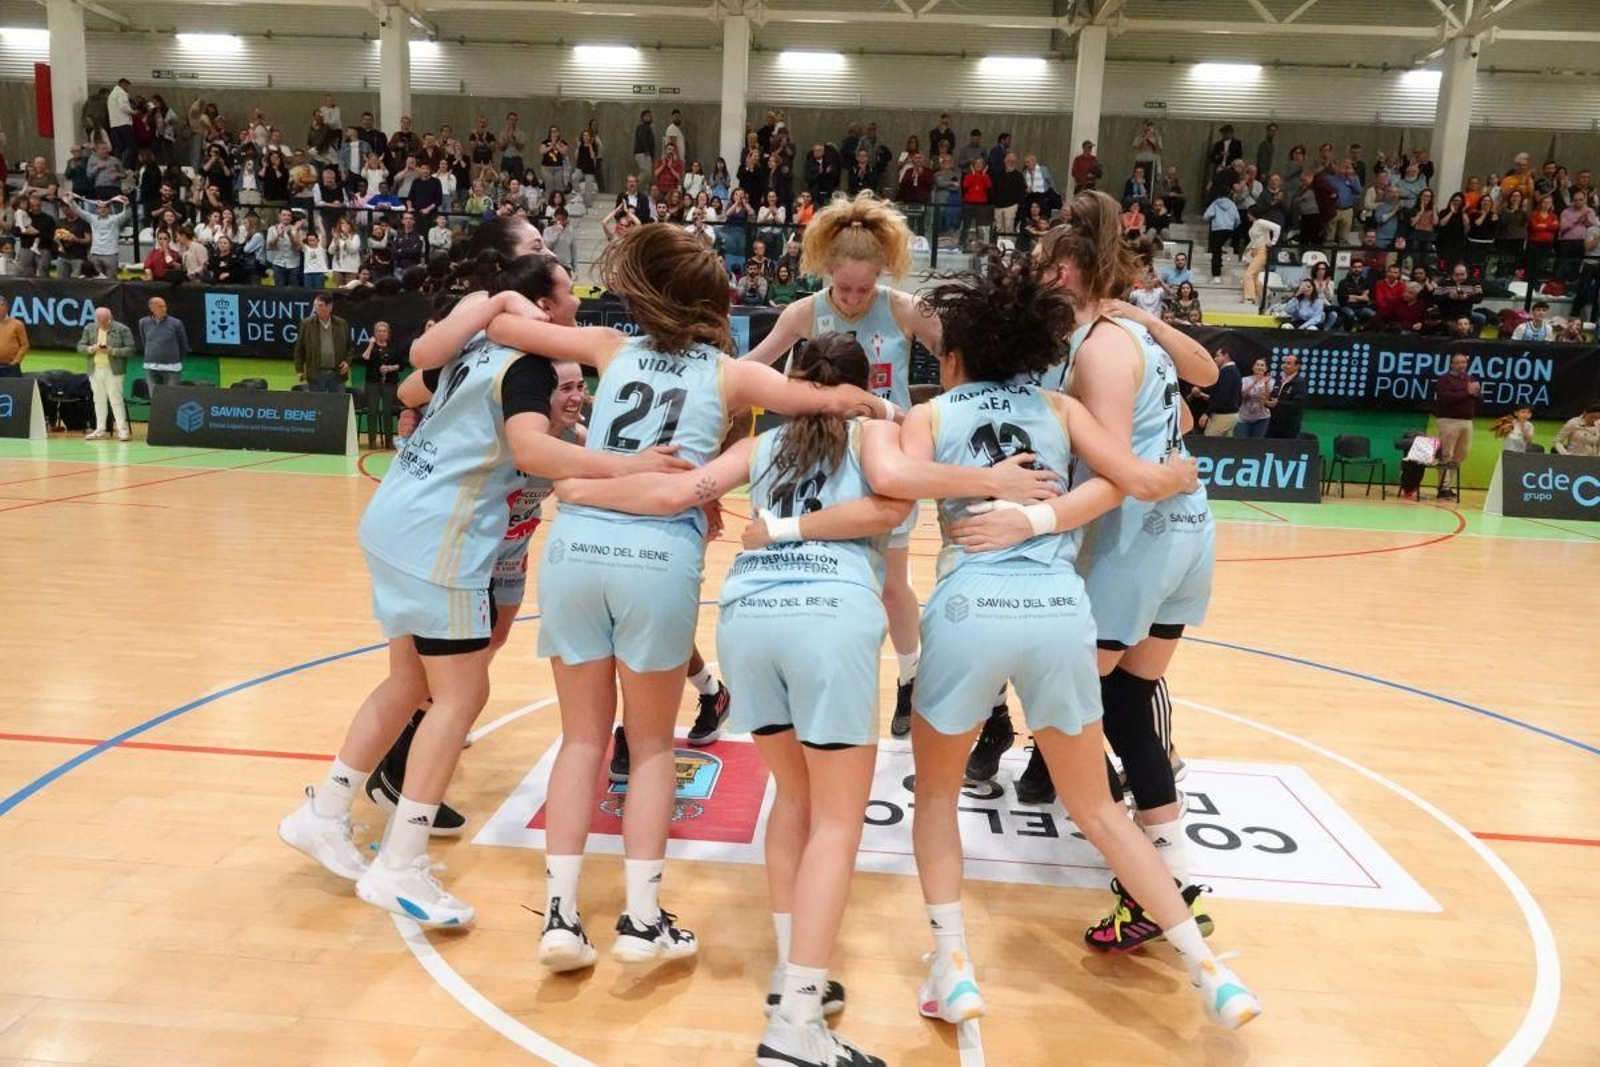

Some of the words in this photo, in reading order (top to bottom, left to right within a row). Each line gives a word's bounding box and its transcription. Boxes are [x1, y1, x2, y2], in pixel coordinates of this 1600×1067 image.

[10, 295, 96, 327] ANCA
[248, 323, 275, 341] DE
[638, 358, 687, 378] VIDAL
[1378, 351, 1553, 382] DEPUACIÓN
[1374, 377, 1550, 406] PONEDRA
[210, 405, 254, 419] SAVINO
[257, 408, 280, 420] DEL
[284, 409, 316, 421] BENE
[602, 381, 689, 453] 21
[1196, 453, 1309, 489] ecalvi
[1522, 467, 1570, 491] cde
[1523, 492, 1553, 502] grupo
[570, 542, 610, 556] SAVINO
[613, 546, 635, 559] DEL
[639, 549, 670, 562] BENE
[739, 597, 778, 609] SAVINO
[780, 598, 802, 608] DEL
[806, 596, 839, 609] BENE
[977, 597, 1020, 609] SAVINO
[1023, 599, 1046, 609] DEL
[1048, 596, 1077, 607] BENE
